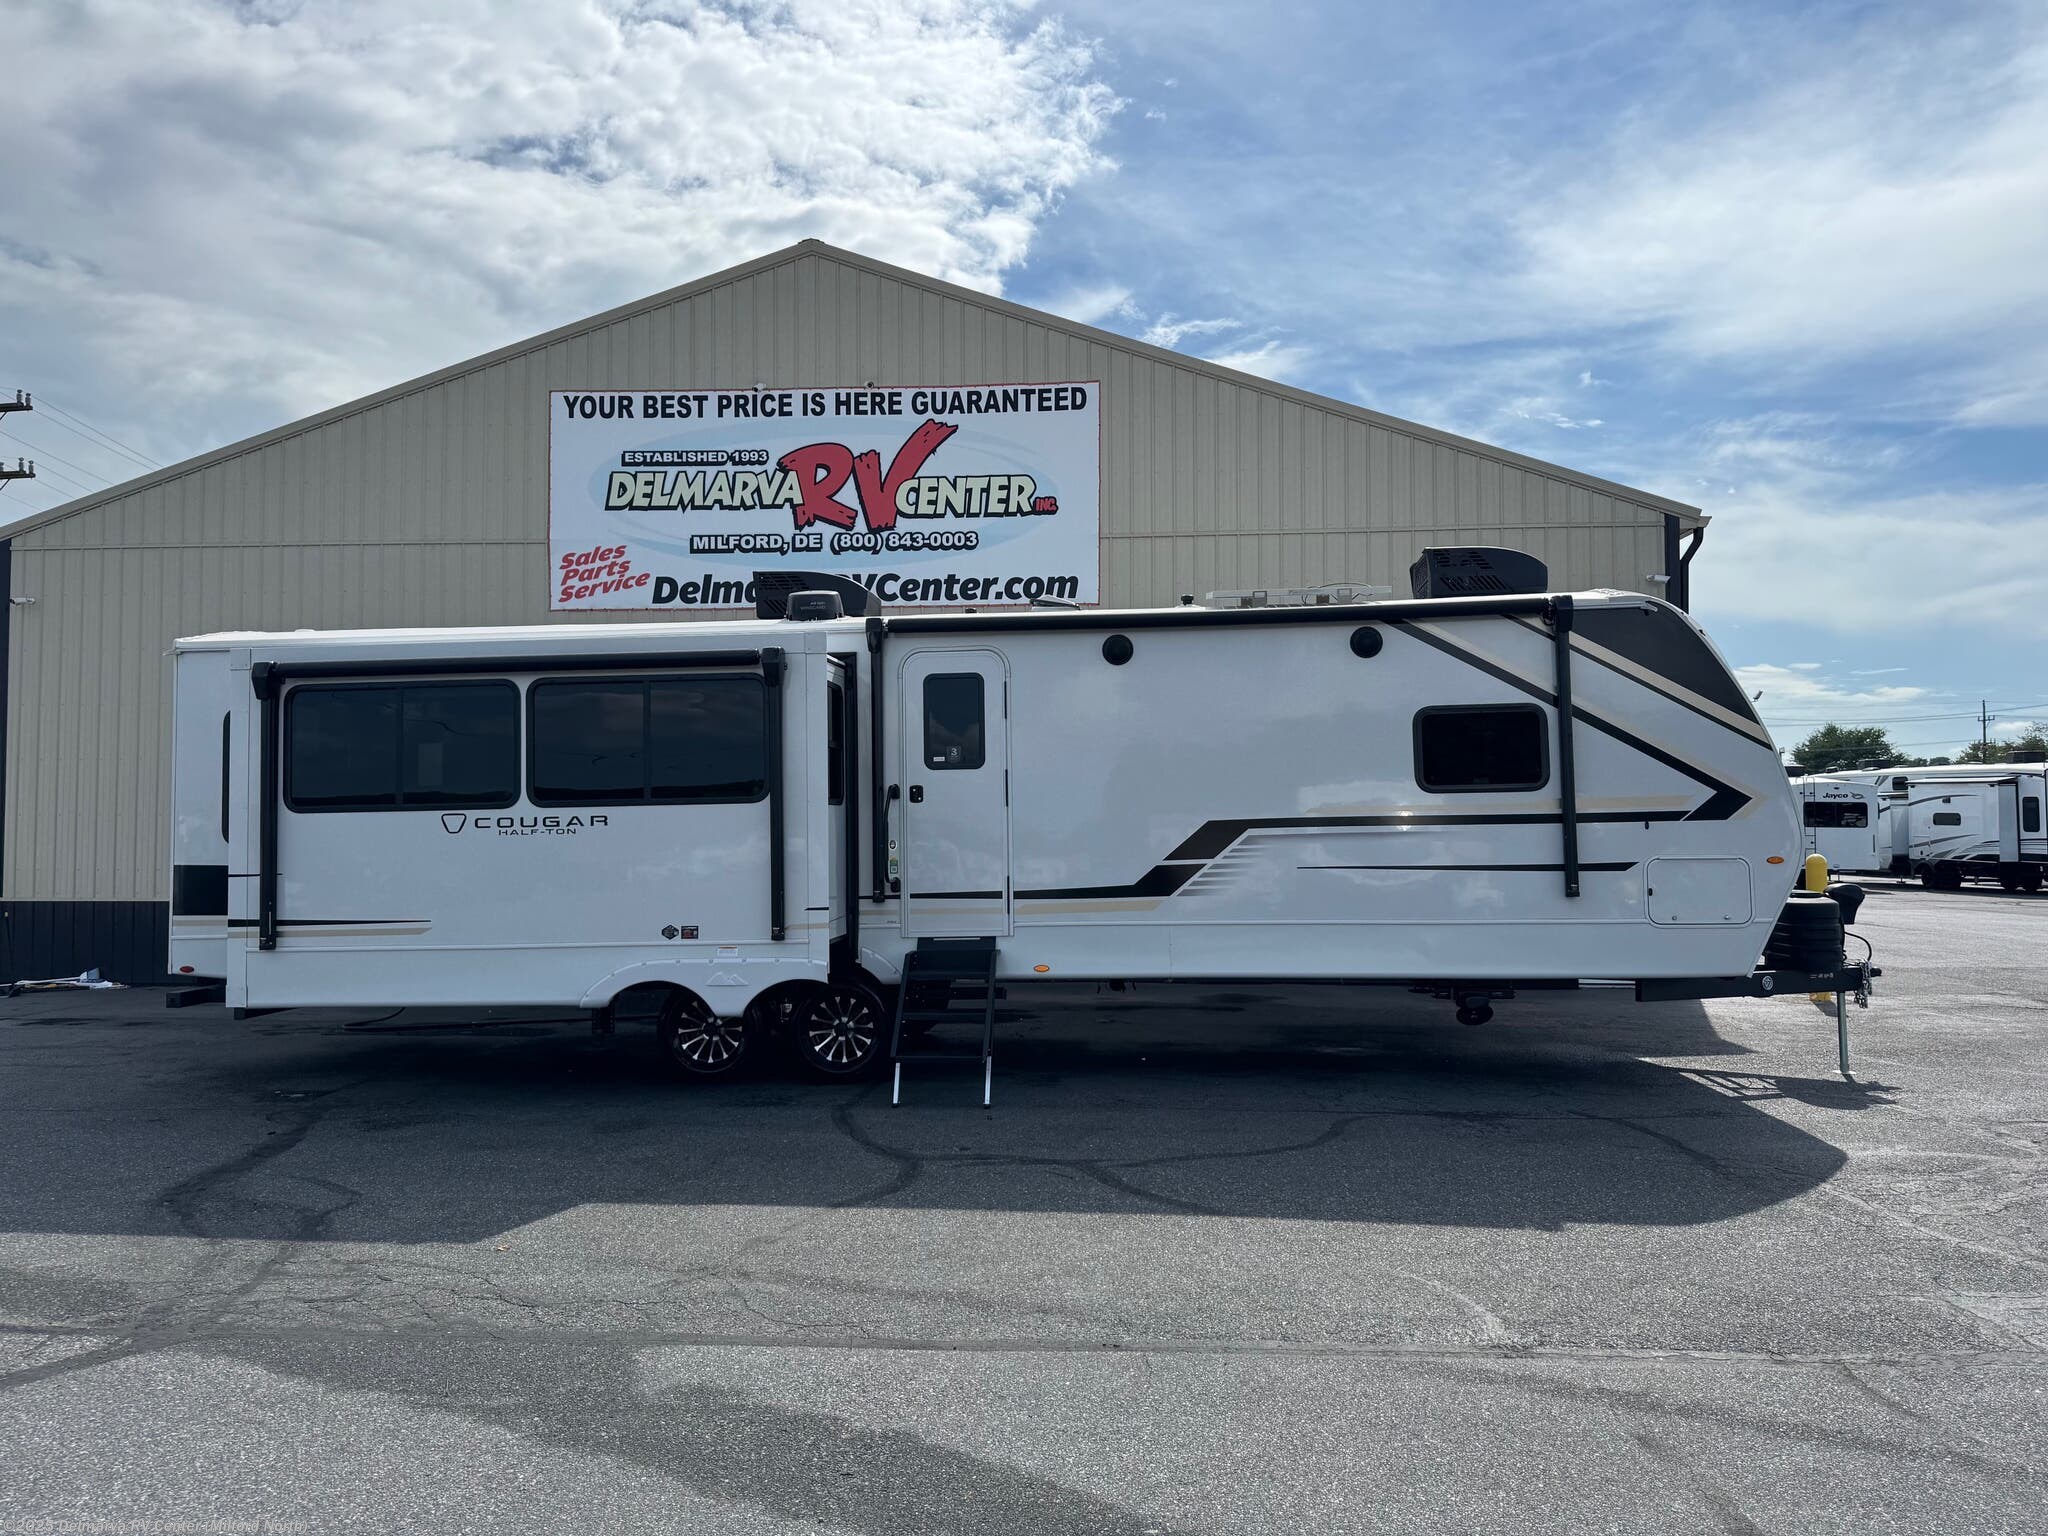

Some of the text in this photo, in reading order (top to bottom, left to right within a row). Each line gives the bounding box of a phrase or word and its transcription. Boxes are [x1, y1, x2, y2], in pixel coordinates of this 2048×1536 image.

[563, 386, 1088, 419] YOUR BEST PRICE IS HERE GUARANTEED
[623, 450, 769, 464] ESTABLISHED 1993
[606, 471, 804, 510] DELMARVA
[777, 419, 958, 532] RV
[895, 474, 1037, 518] CENTER
[692, 531, 979, 553] MILFORD, DE (800) 843-0003
[559, 545, 628, 570] Sales
[561, 559, 632, 586] Parts
[558, 572, 651, 602] Service
[474, 815, 609, 828] COUGAR
[498, 828, 577, 836] HALF-TON
